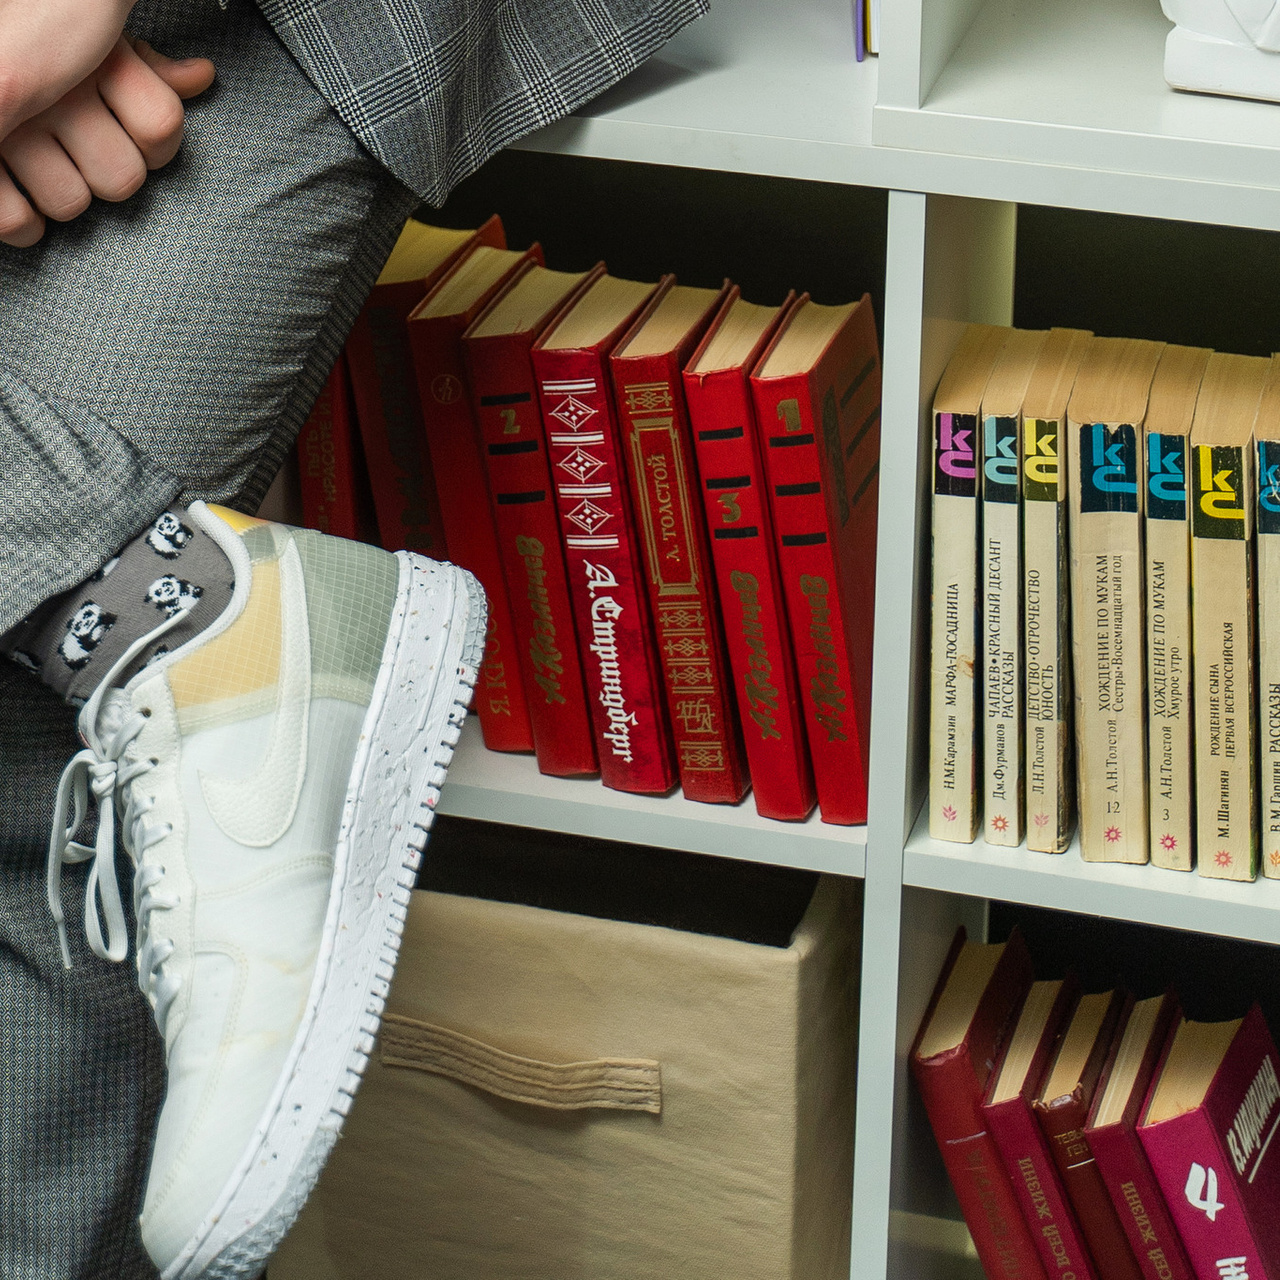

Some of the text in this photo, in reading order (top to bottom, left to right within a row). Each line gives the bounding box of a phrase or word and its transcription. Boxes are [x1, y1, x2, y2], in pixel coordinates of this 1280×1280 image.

[500, 408, 521, 435] 2
[650, 453, 680, 538] ТОЛСТОЙ
[720, 494, 742, 524] 3
[989, 537, 1002, 591] ДЕСАНТ
[1094, 553, 1110, 604] МУКАМ
[1151, 559, 1167, 610] МУКАМ
[944, 581, 961, 708] МАРФА-ПОСАДНИЦА
[1095, 607, 1111, 629] ПО
[1152, 612, 1166, 634] ПО
[1001, 649, 1015, 720] РАССКАЗЫ
[1041, 663, 1056, 721] ЮНОСТЬ
[1097, 630, 1110, 713] ХОЖДЕНИЕ
[1153, 636, 1166, 719] ХОЖДЕНИЕ
[1167, 646, 1182, 721] Хмурое утро
[1208, 662, 1223, 694] СЫНА
[1223, 621, 1237, 759] ПЕРВАЯ ВСЕРОССИЙСКАЯ
[1209, 696, 1223, 758] РОЖДЕНИЕ
[1018, 1157, 1052, 1220] ЖИЗНИ
[1121, 1180, 1158, 1244] ЖИЗНИ
[1042, 1223, 1069, 1269] ВСЕЙ
